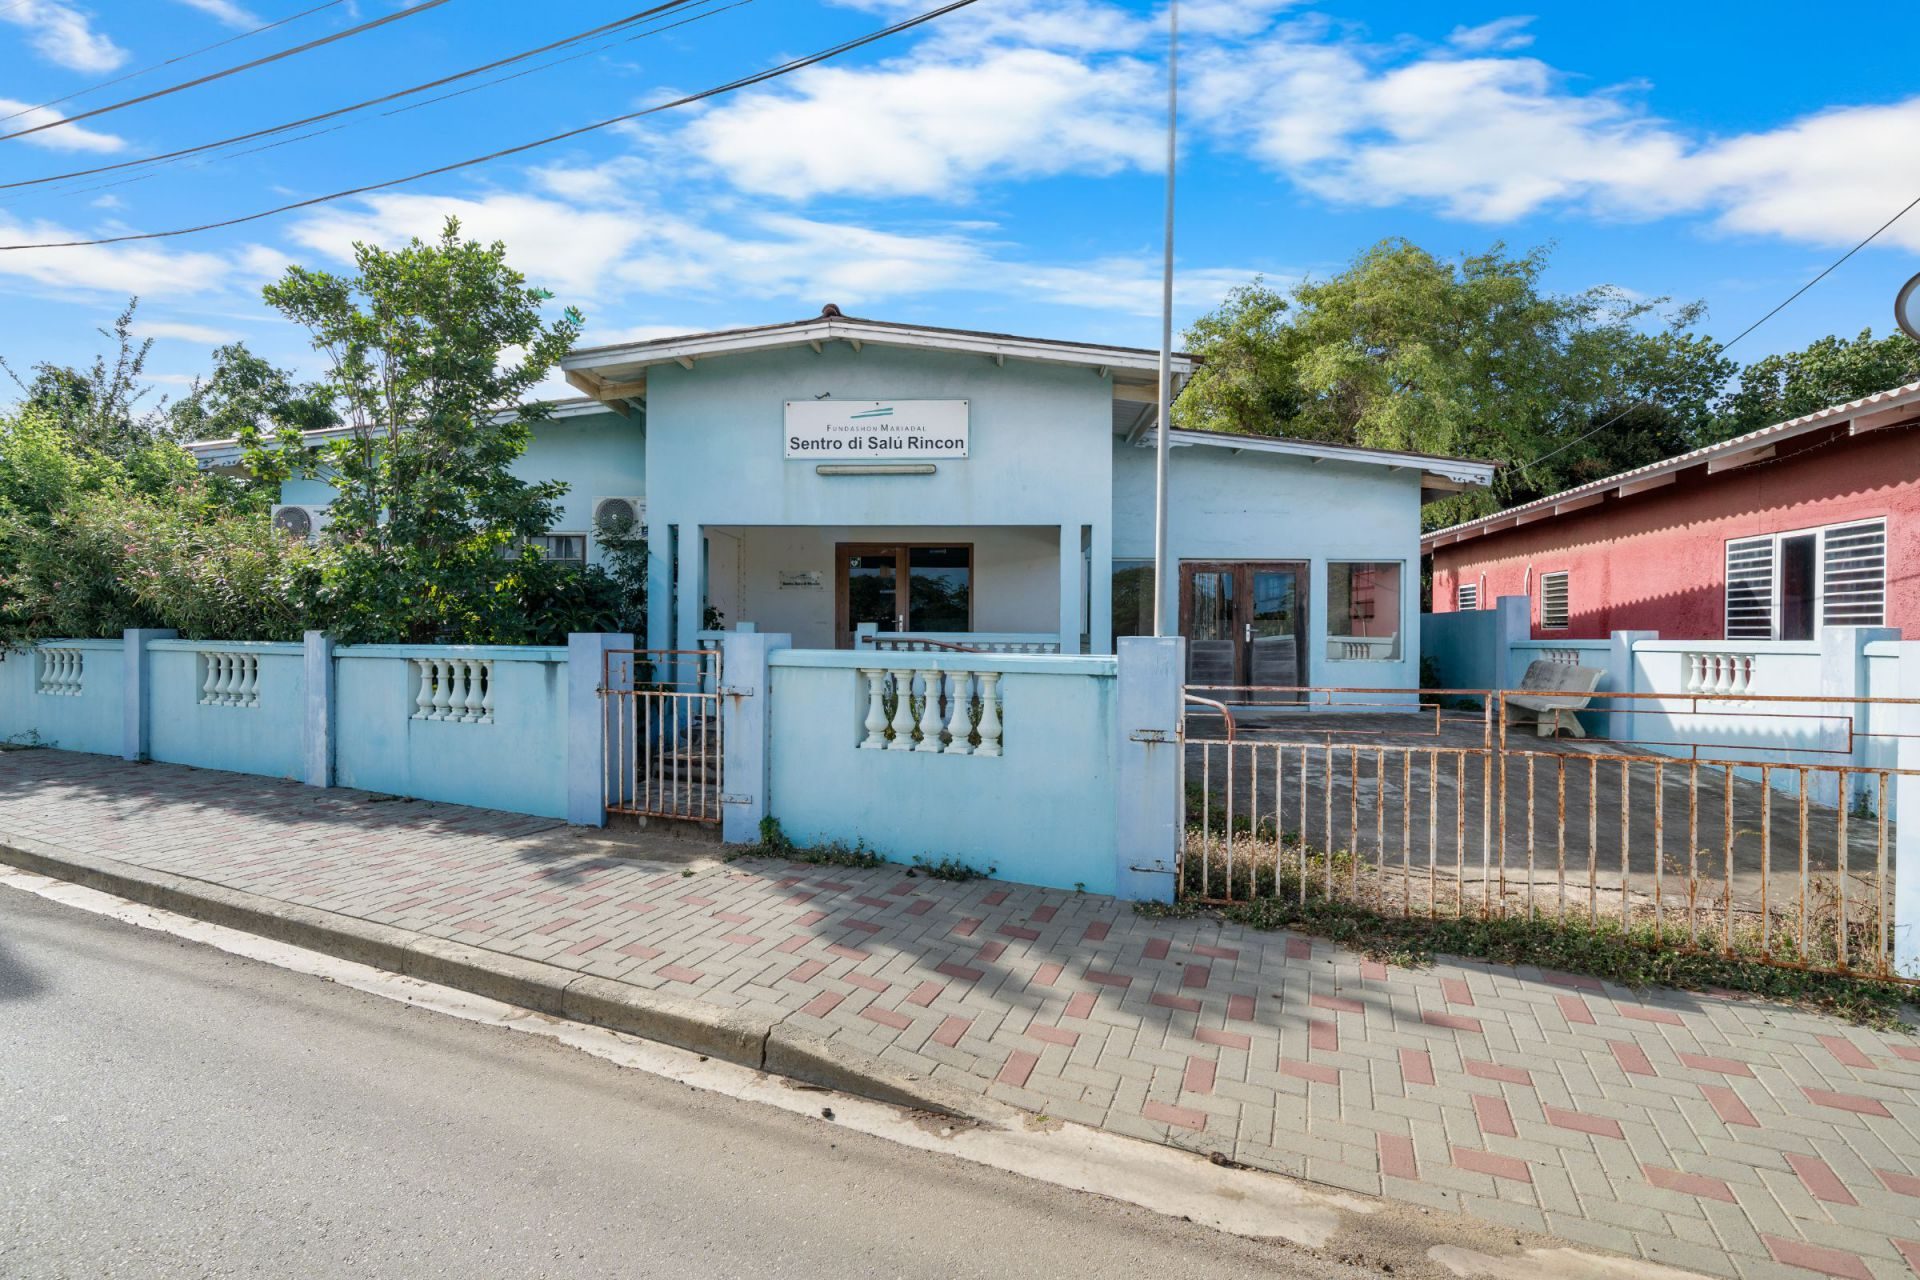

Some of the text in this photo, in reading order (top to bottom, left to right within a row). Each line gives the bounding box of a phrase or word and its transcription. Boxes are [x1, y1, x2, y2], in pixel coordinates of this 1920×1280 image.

[790, 436, 964, 450] Sentro di Salú Rincon
